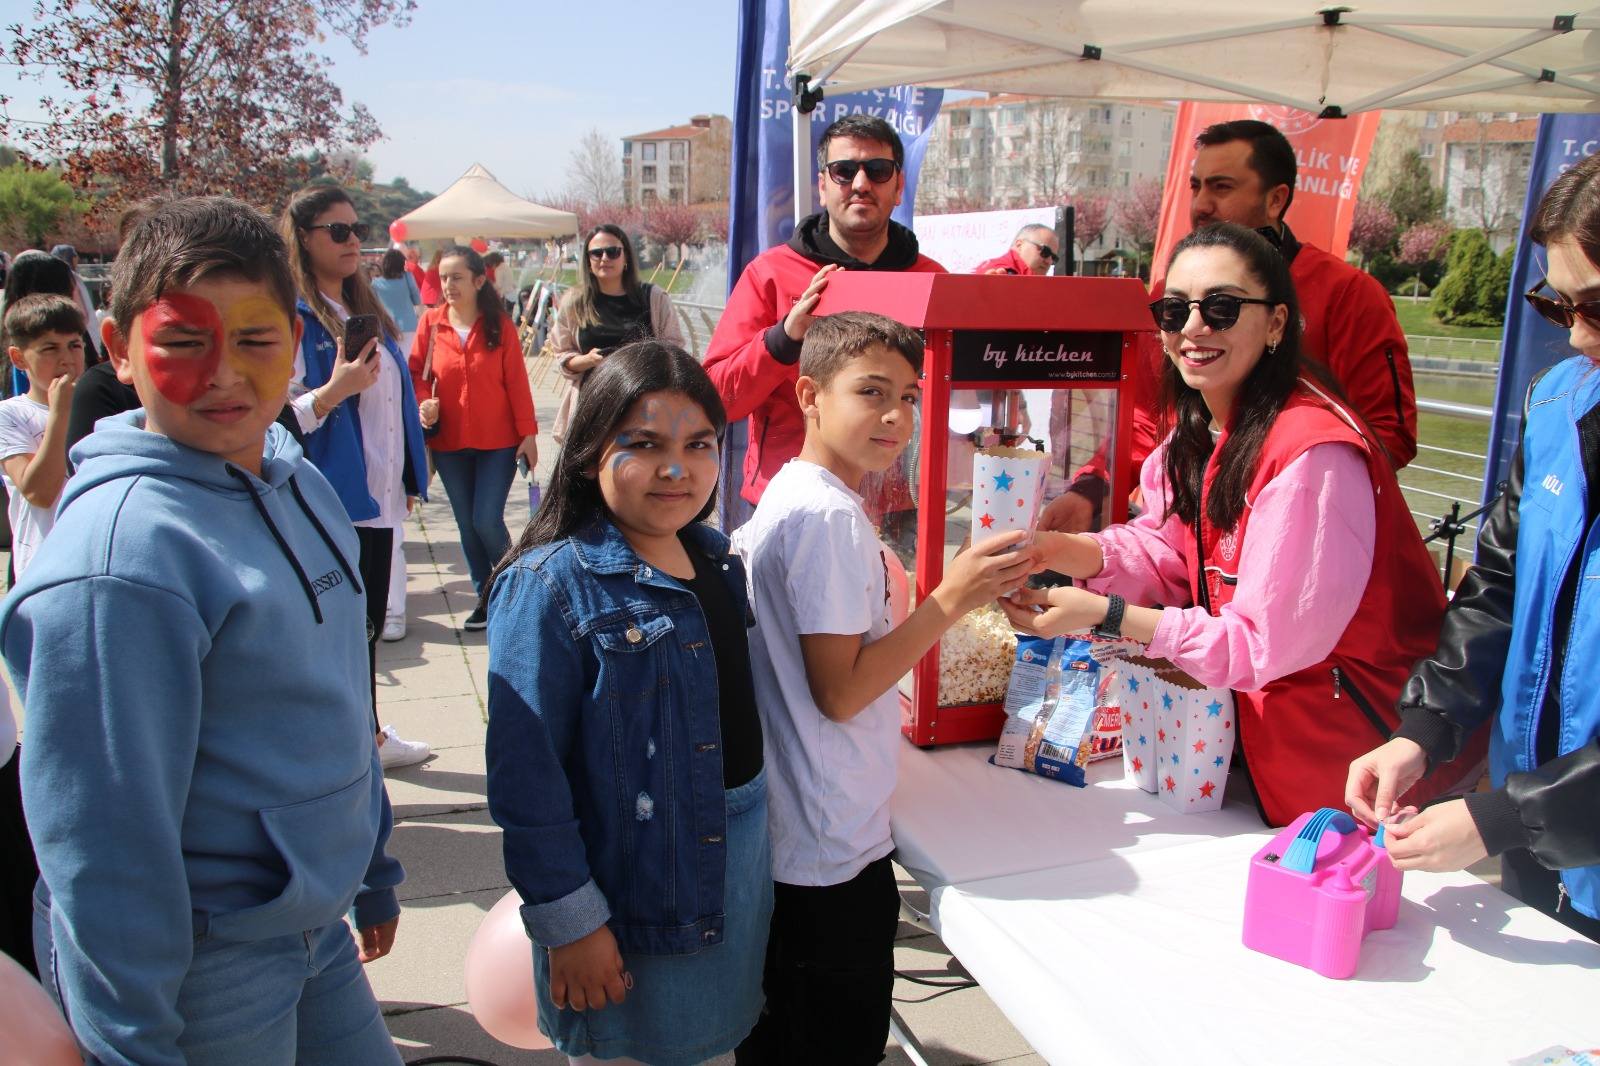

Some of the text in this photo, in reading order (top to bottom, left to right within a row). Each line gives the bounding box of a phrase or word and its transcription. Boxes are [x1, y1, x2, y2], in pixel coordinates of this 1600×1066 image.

[761, 99, 826, 122] SPR
[1294, 147, 1360, 176] LİK VE
[1295, 173, 1353, 200] ANLIĞI
[983, 343, 1093, 368] by kitchen
